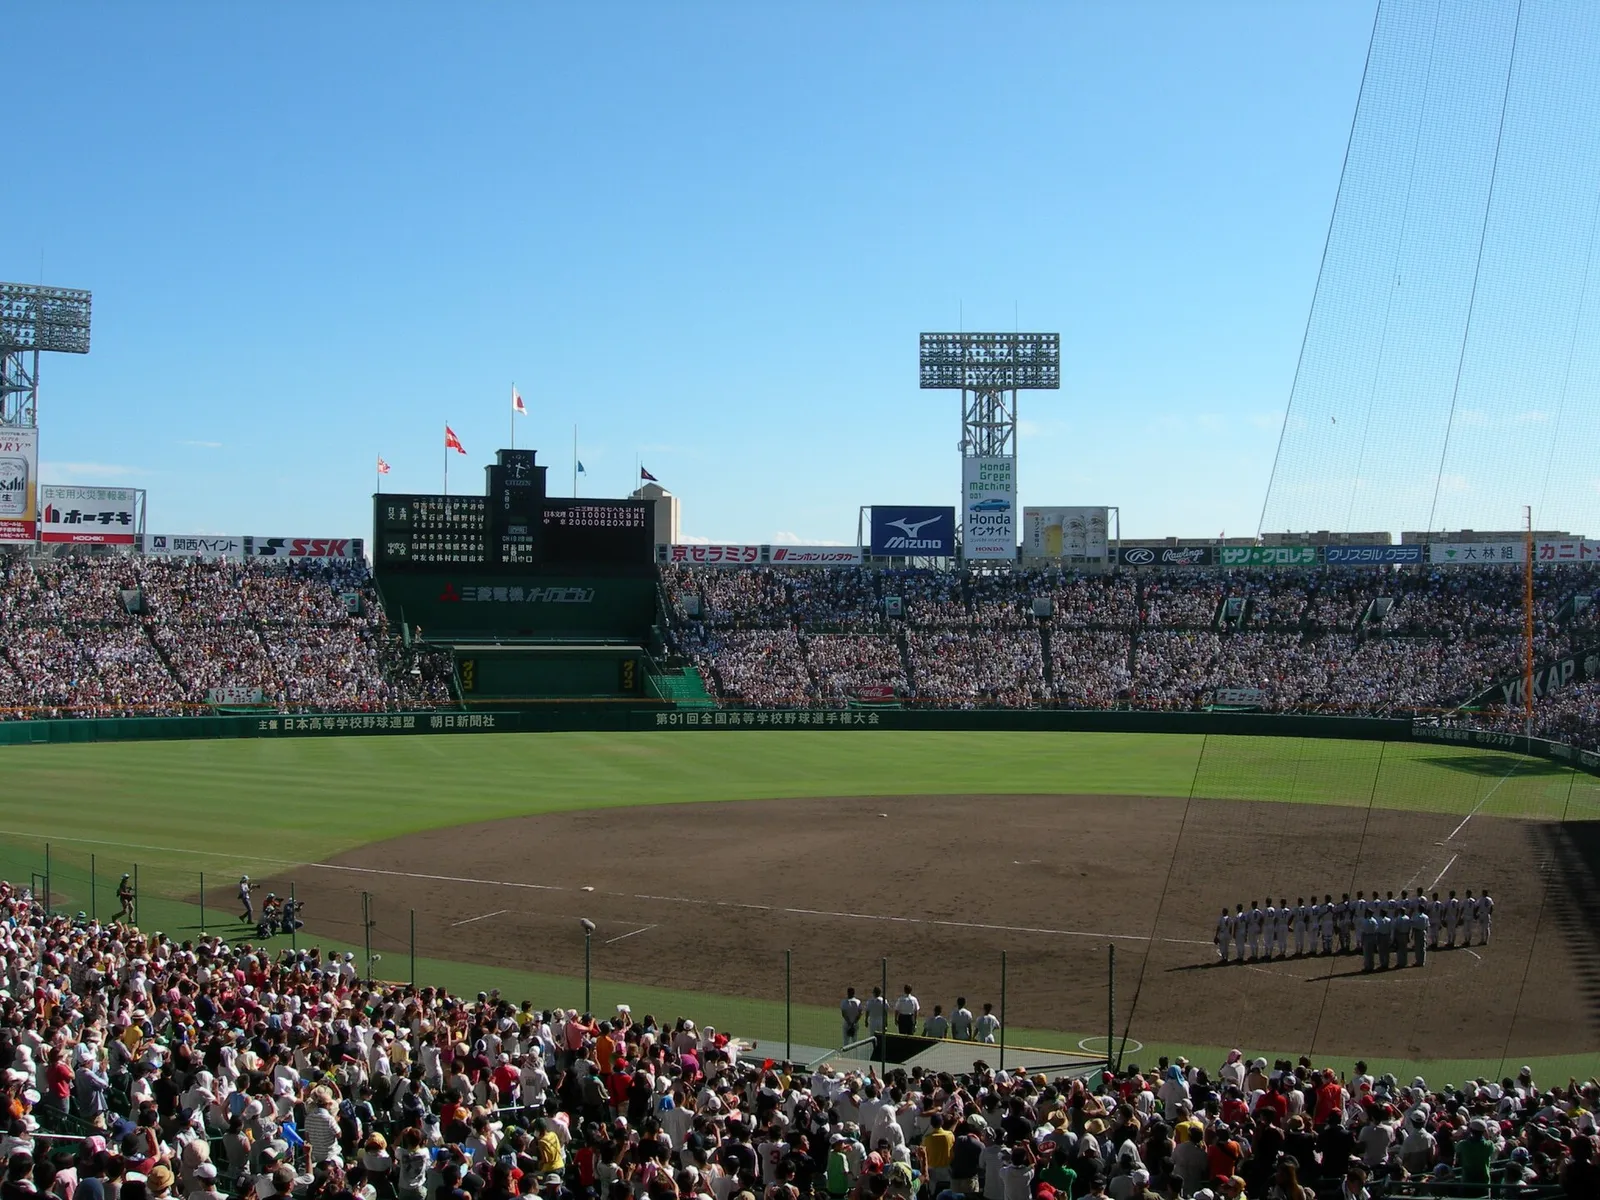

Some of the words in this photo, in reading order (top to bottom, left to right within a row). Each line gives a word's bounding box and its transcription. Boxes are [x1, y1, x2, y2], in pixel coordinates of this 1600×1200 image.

[980, 463, 1010, 471] Honda
[980, 472, 1010, 482] Green
[63, 510, 132, 525] ホーチキ
[970, 514, 1010, 524] Honda
[970, 526, 1010, 536] インサイト
[174, 539, 238, 551] 関西ペイント
[288, 539, 350, 556] SSK
[671, 546, 758, 563] 京セラミタ
[787, 552, 859, 561] ニッポンレンタカー
[1162, 548, 1204, 562] Rawlings
[1328, 549, 1382, 561] クリスタル
[1386, 548, 1418, 560] クララ
[1464, 546, 1513, 560] 大林組
[258, 720, 277, 730] 主催
[284, 718, 415, 730] 日本高等学校野球連盟
[430, 715, 495, 728] 朝日新聞社
[656, 712, 880, 725] 第91回全国高等学校野球選手権大会
[770, 1150, 780, 1164] 3
